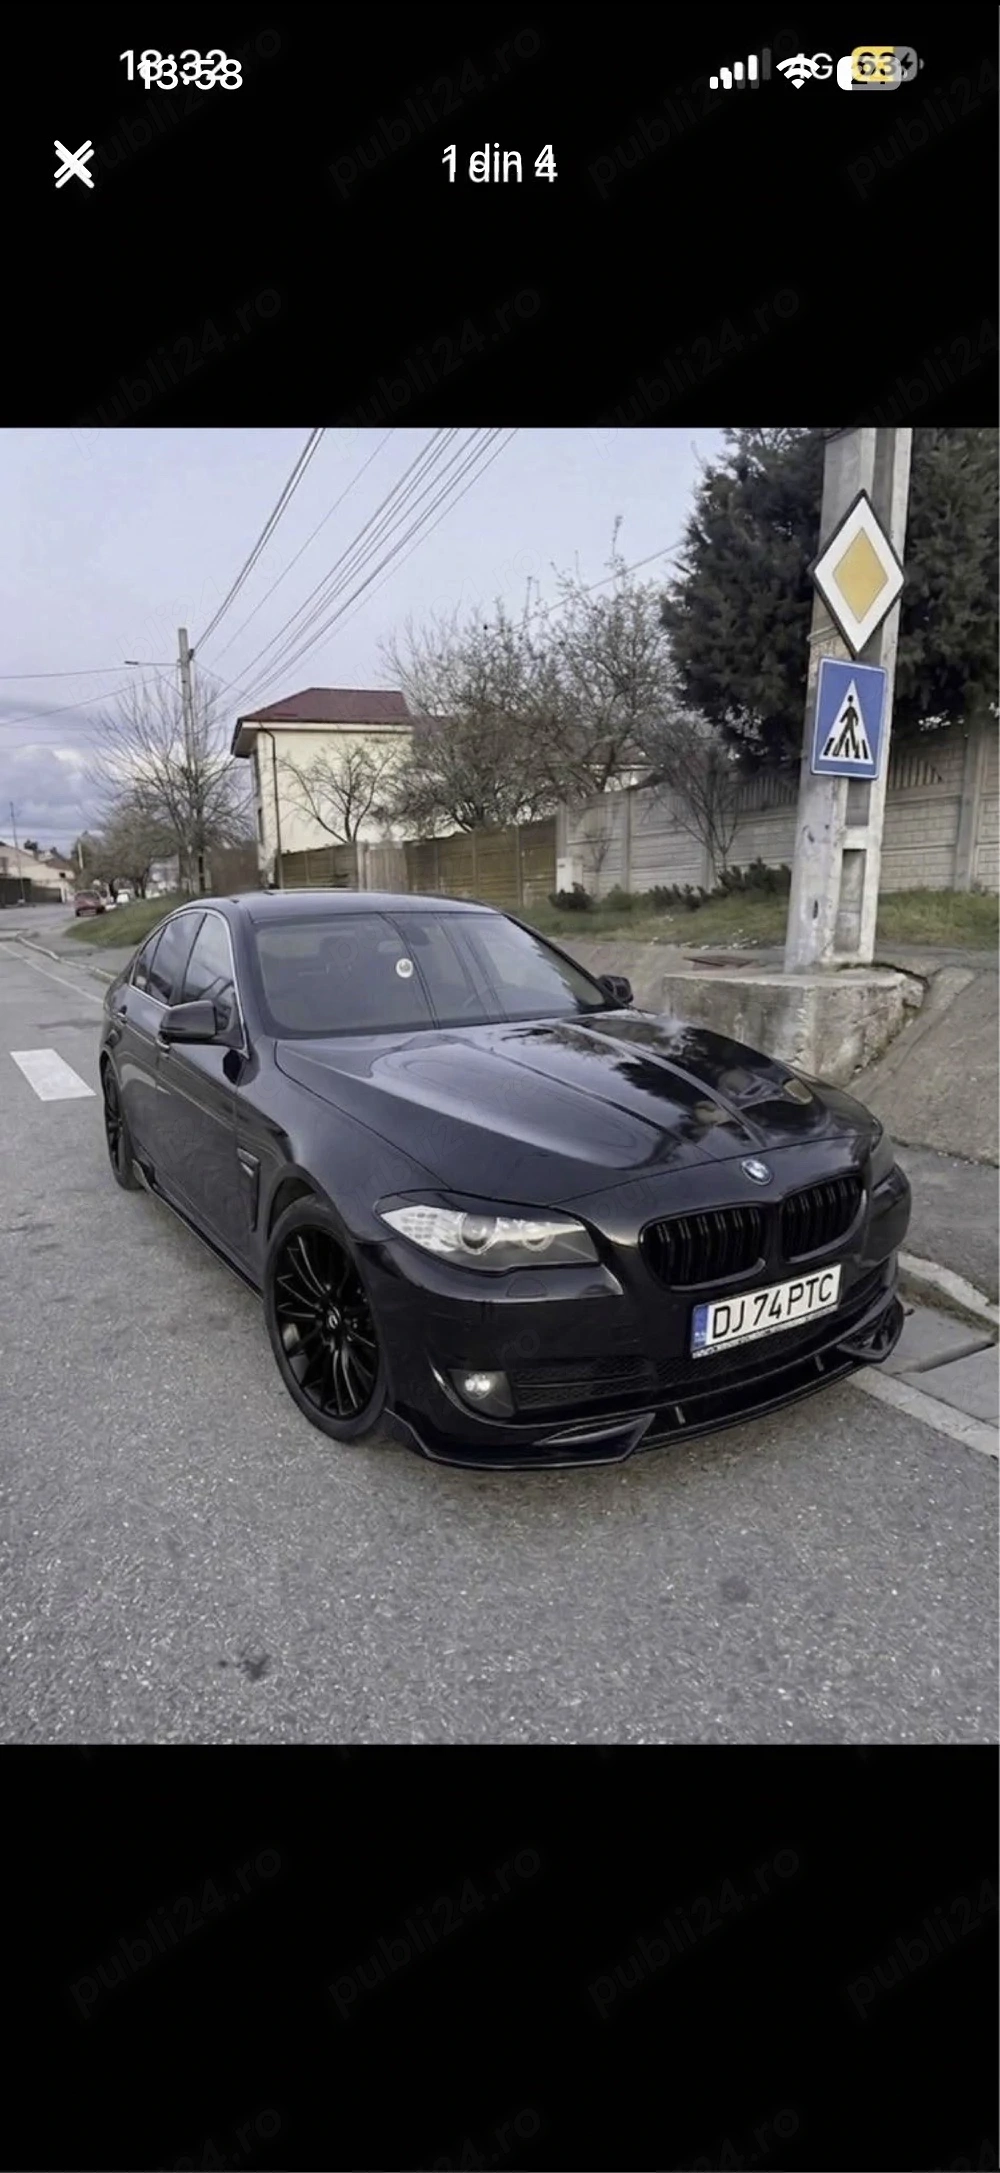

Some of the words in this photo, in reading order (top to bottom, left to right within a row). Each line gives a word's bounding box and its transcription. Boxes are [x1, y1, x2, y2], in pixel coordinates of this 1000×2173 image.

[712, 1300, 745, 1340] DJ
[753, 1289, 782, 1327] 74
[786, 1273, 834, 1316] PTC
